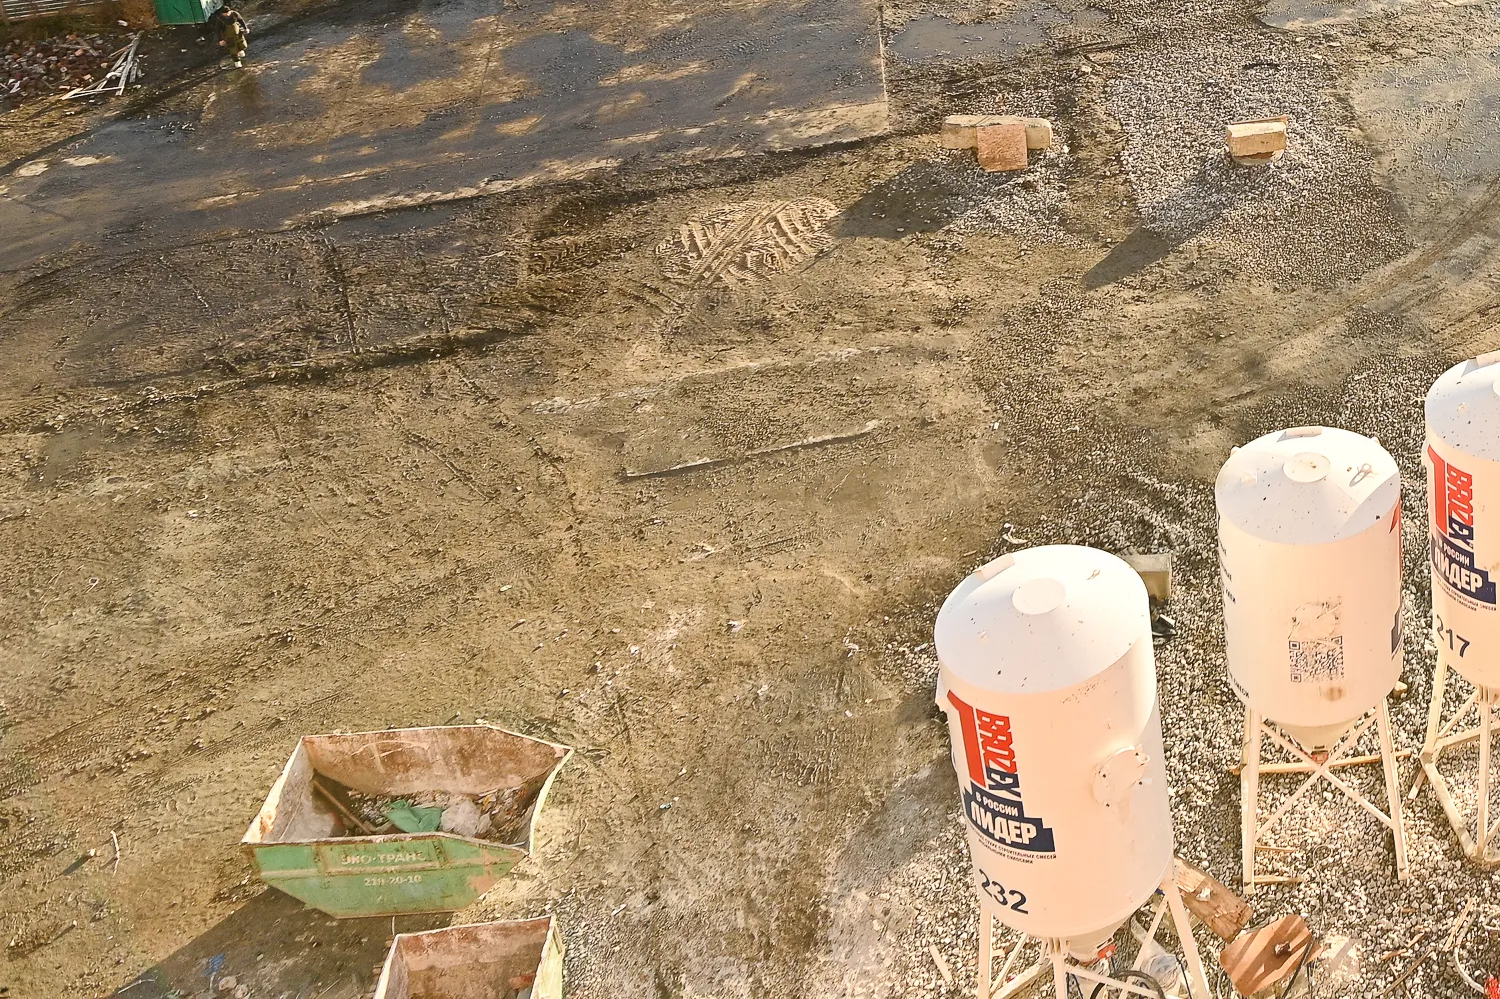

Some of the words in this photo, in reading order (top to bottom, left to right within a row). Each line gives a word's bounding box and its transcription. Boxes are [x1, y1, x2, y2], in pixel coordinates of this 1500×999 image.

[1434, 546, 1483, 594] ЛИДЕР
[1443, 542, 1470, 567] РОССИИ
[1436, 613, 1470, 659] 217
[970, 800, 1037, 845] ЛИДЕР
[975, 791, 982, 802] В
[983, 796, 1019, 818] РОССИИ
[1035, 853, 1057, 861] СМЕСЕЙ
[978, 868, 1029, 915] 232
